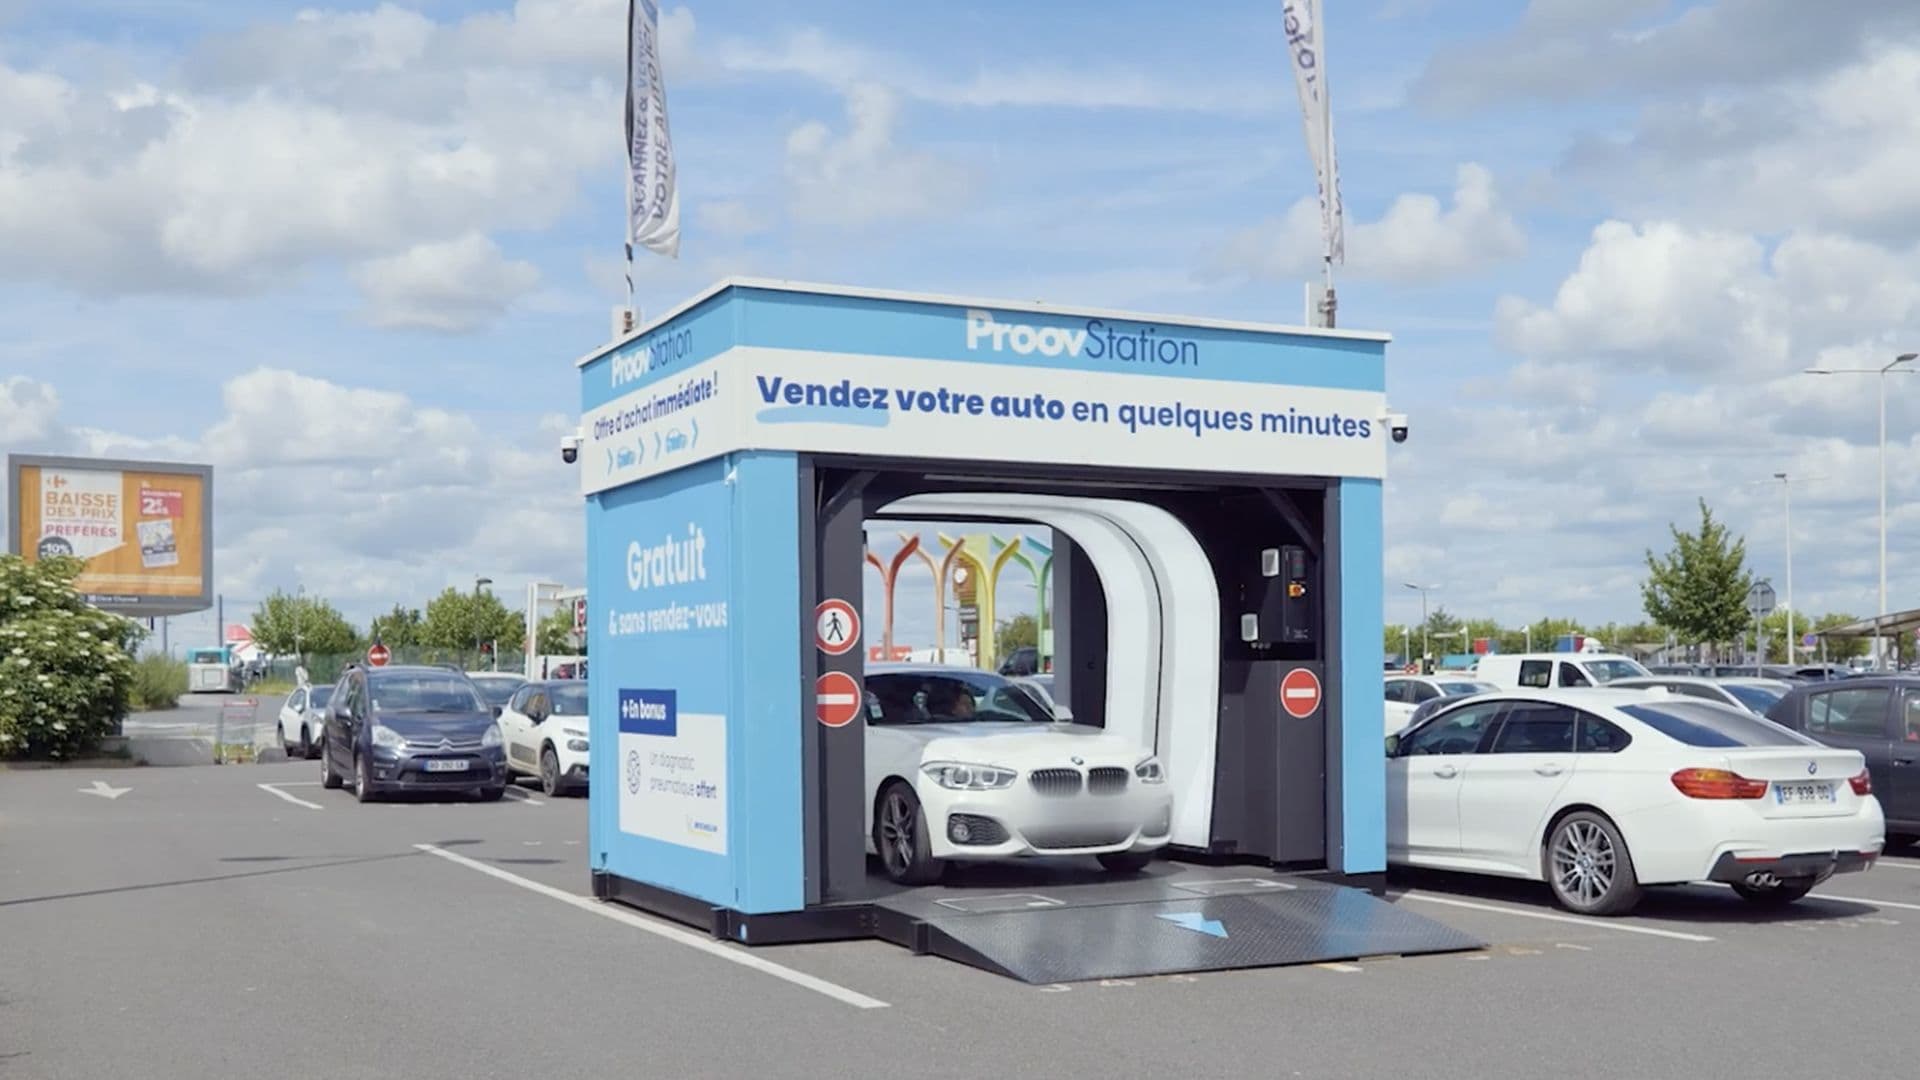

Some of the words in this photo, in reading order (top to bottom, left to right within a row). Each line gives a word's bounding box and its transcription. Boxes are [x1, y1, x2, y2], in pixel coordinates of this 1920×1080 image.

[652, 136, 668, 219] VOTRE
[611, 327, 693, 388] ProovStation
[967, 308, 1199, 366] ProovStation
[593, 417, 615, 441] Offre
[756, 375, 889, 410] Vendez
[895, 388, 984, 414] votre
[990, 394, 1065, 420] auto
[1072, 401, 1109, 423] en
[1118, 402, 1253, 437] quelques
[1260, 408, 1371, 438] minutes
[46, 491, 117, 508] BAISSE
[46, 507, 77, 517] DES
[81, 508, 117, 520] PRIX
[627, 521, 706, 591] Gratuit
[619, 610, 645, 635] sans
[648, 601, 728, 632] rendez-vous
[629, 699, 640, 719] En
[640, 698, 667, 721] bonus
